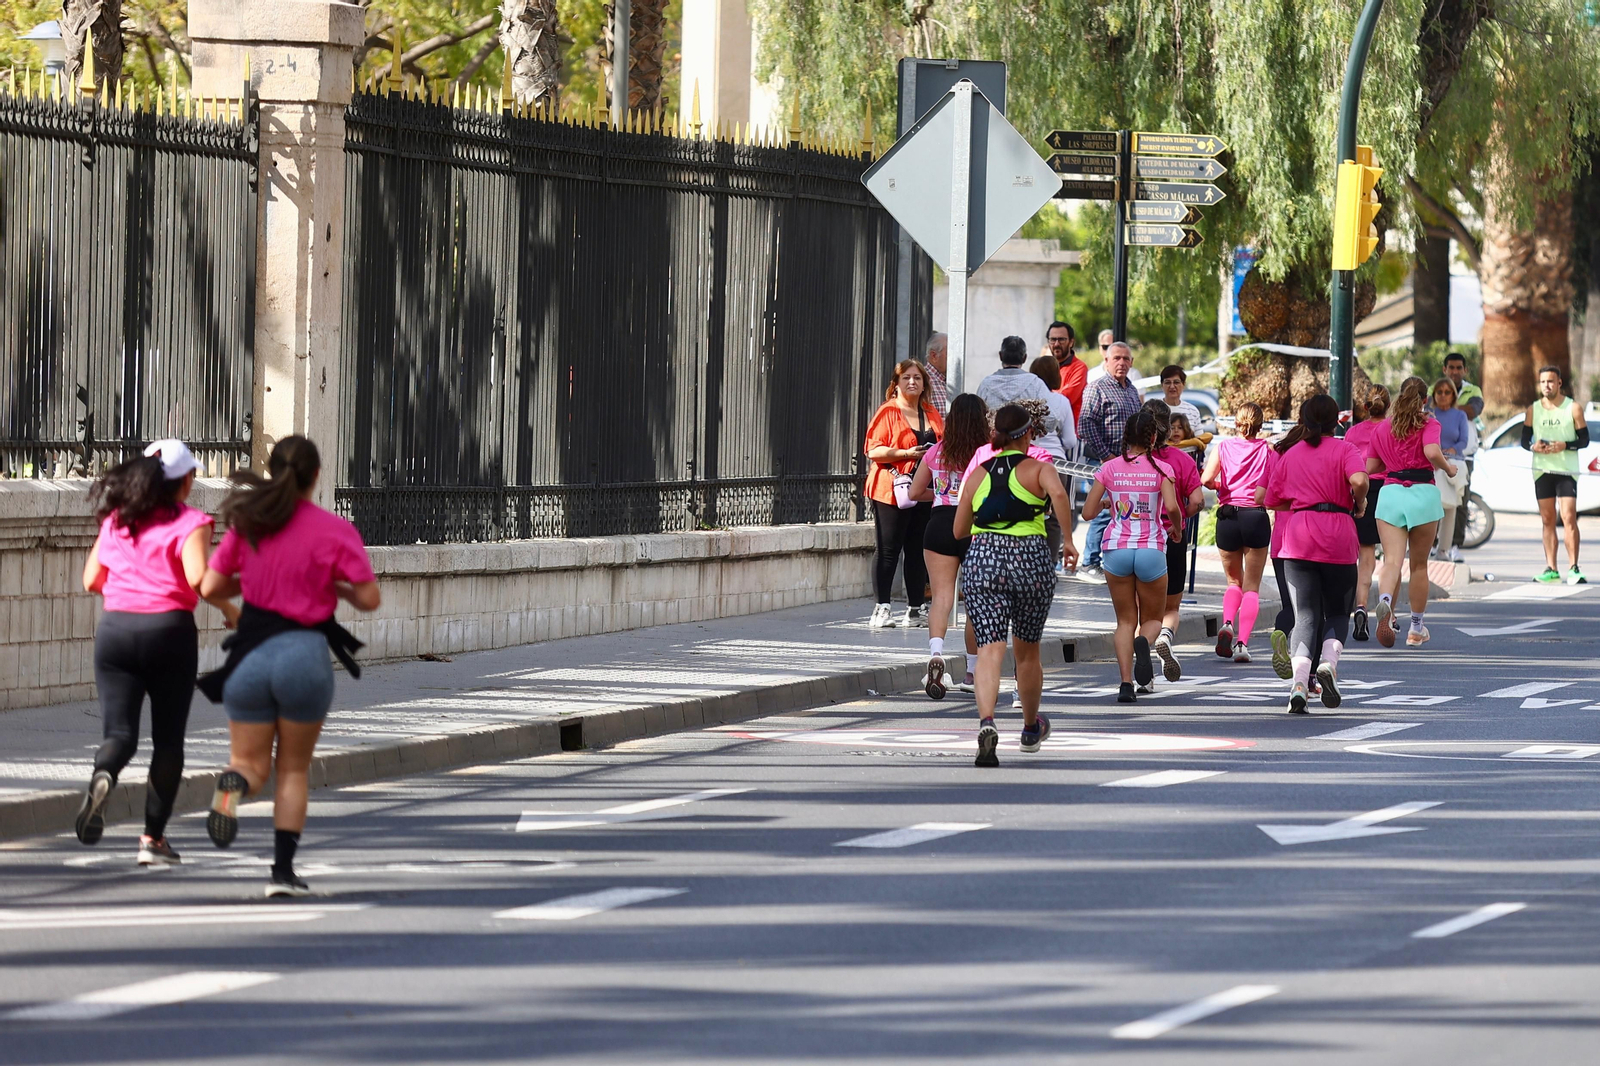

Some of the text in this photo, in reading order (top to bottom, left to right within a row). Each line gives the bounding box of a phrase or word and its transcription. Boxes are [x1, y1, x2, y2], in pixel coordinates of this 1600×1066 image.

[1082, 141, 1114, 150] SORPRESAS
[1063, 156, 1081, 164] MUSEO
[1139, 184, 1160, 192] MUSEO
[1138, 191, 1199, 202] PICASSO MÁLAGA
